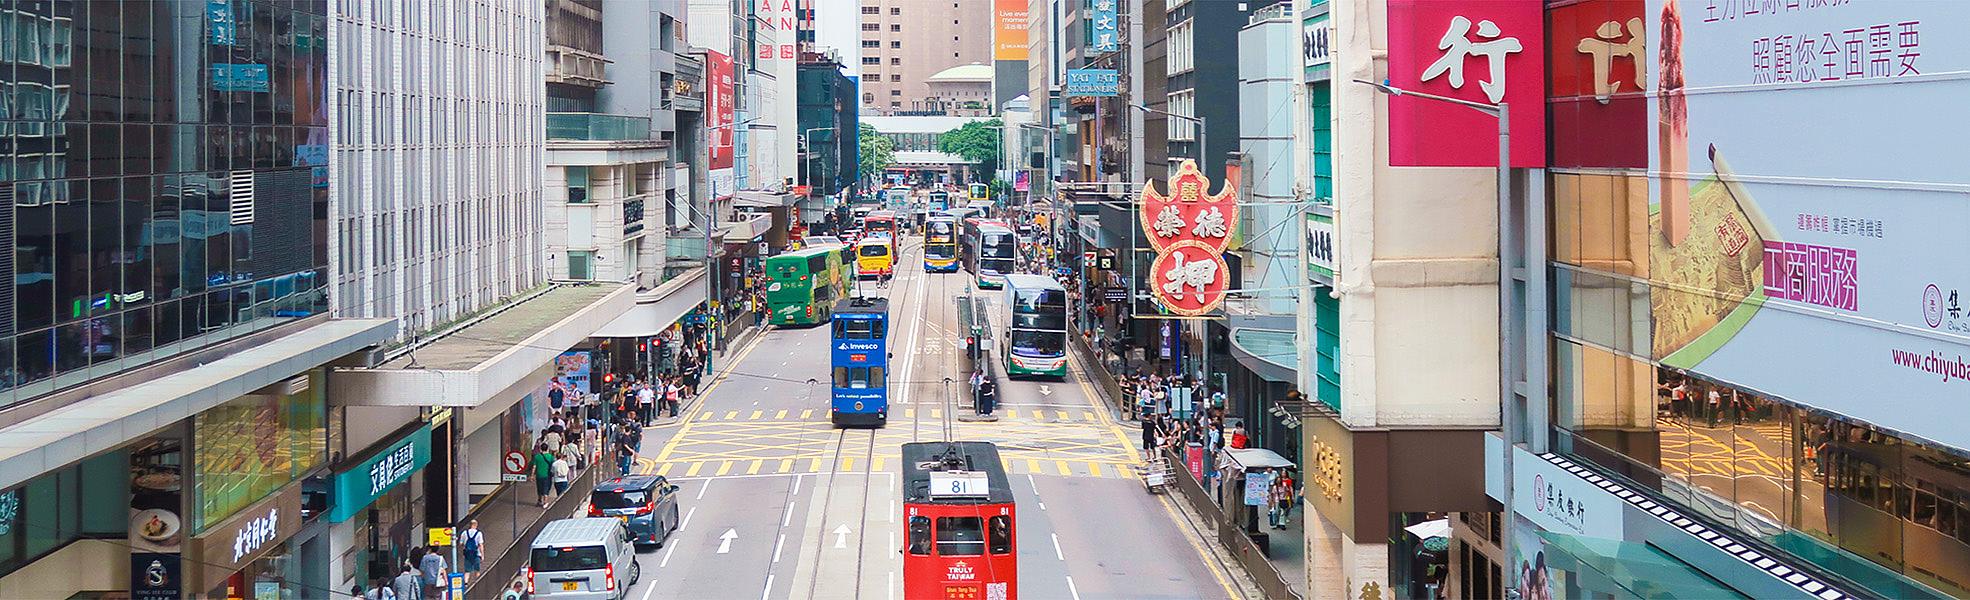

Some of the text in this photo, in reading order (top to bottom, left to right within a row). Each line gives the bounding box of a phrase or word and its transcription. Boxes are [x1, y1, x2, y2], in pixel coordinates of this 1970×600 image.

[1752, 20, 1921, 85] 照顧您全面需要
[1421, 15, 1523, 104] 行
[1070, 73, 1115, 82] YAT FAT
[1068, 85, 1118, 93] STATIONERS
[1163, 251, 1218, 304] 押
[1764, 244, 1858, 312] 工商服務
[951, 480, 967, 493] 81
[909, 507, 918, 515] 81
[1000, 507, 1008, 515] 81
